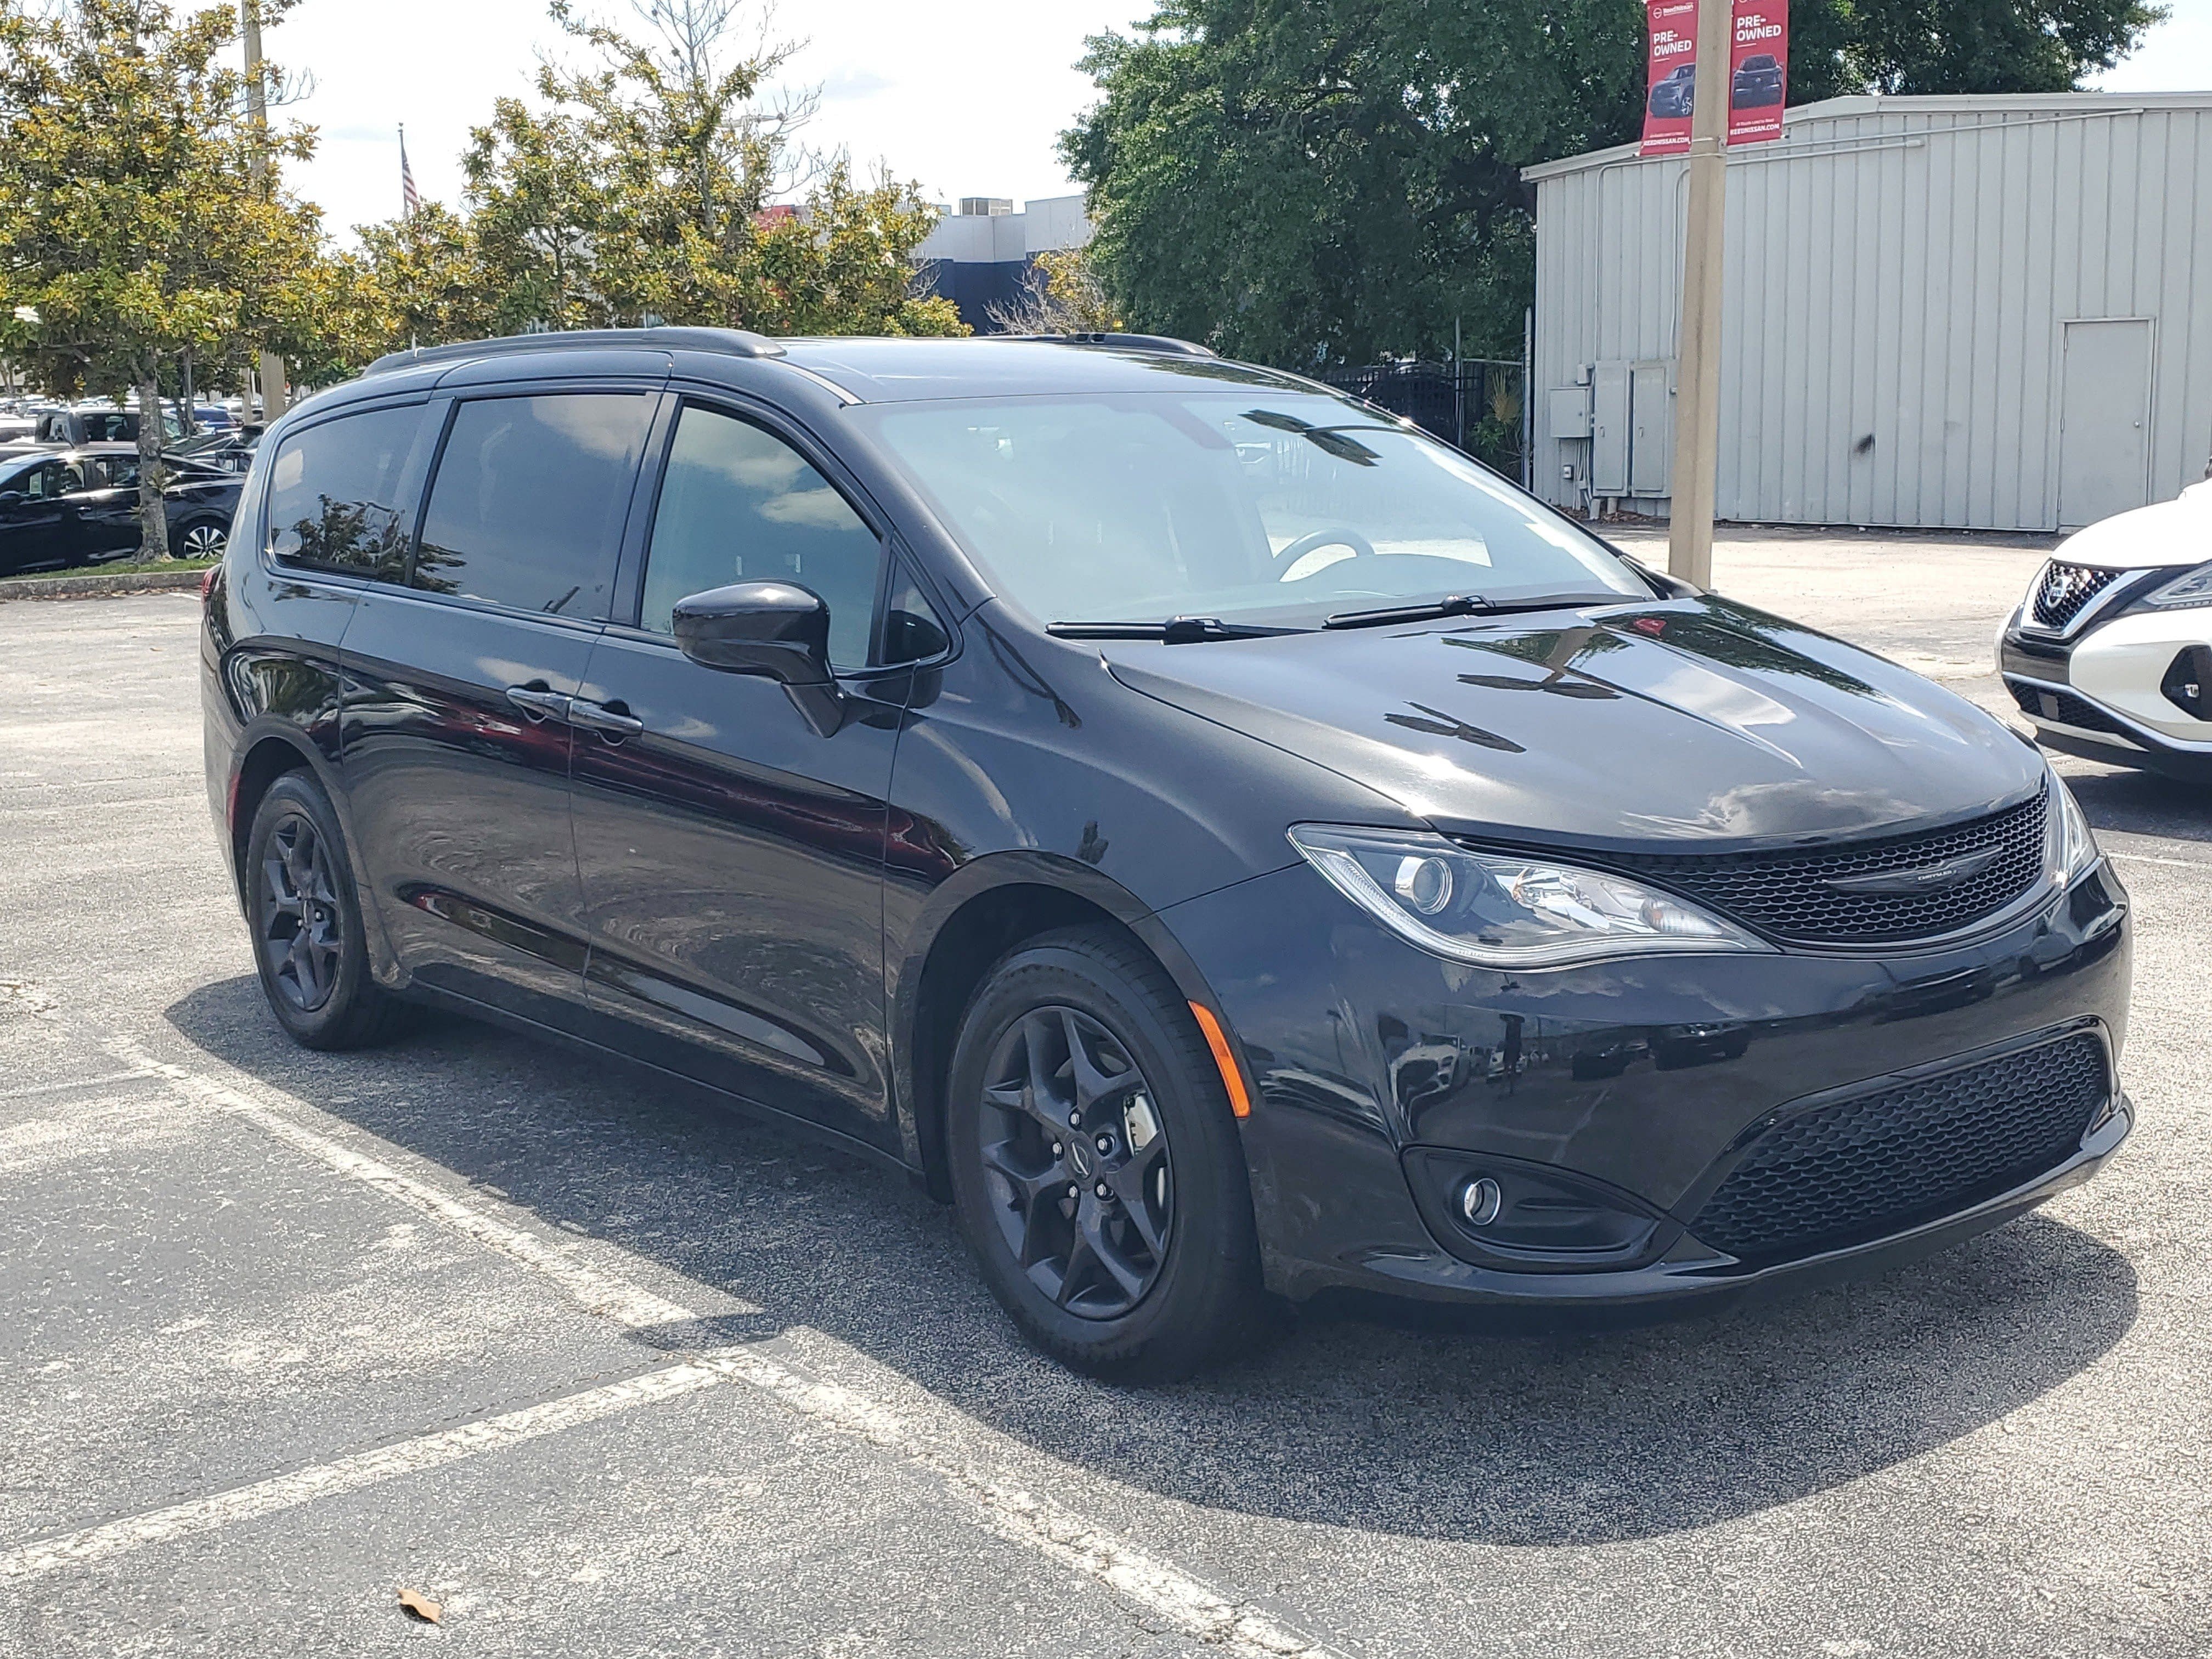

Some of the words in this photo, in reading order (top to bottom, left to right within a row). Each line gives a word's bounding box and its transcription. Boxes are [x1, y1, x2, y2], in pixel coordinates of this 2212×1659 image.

[1737, 15, 1767, 29] PRE-
[1654, 31, 1678, 45] PRE-
[1736, 25, 1782, 41] OWNED
[1654, 40, 1692, 56] OWNED
